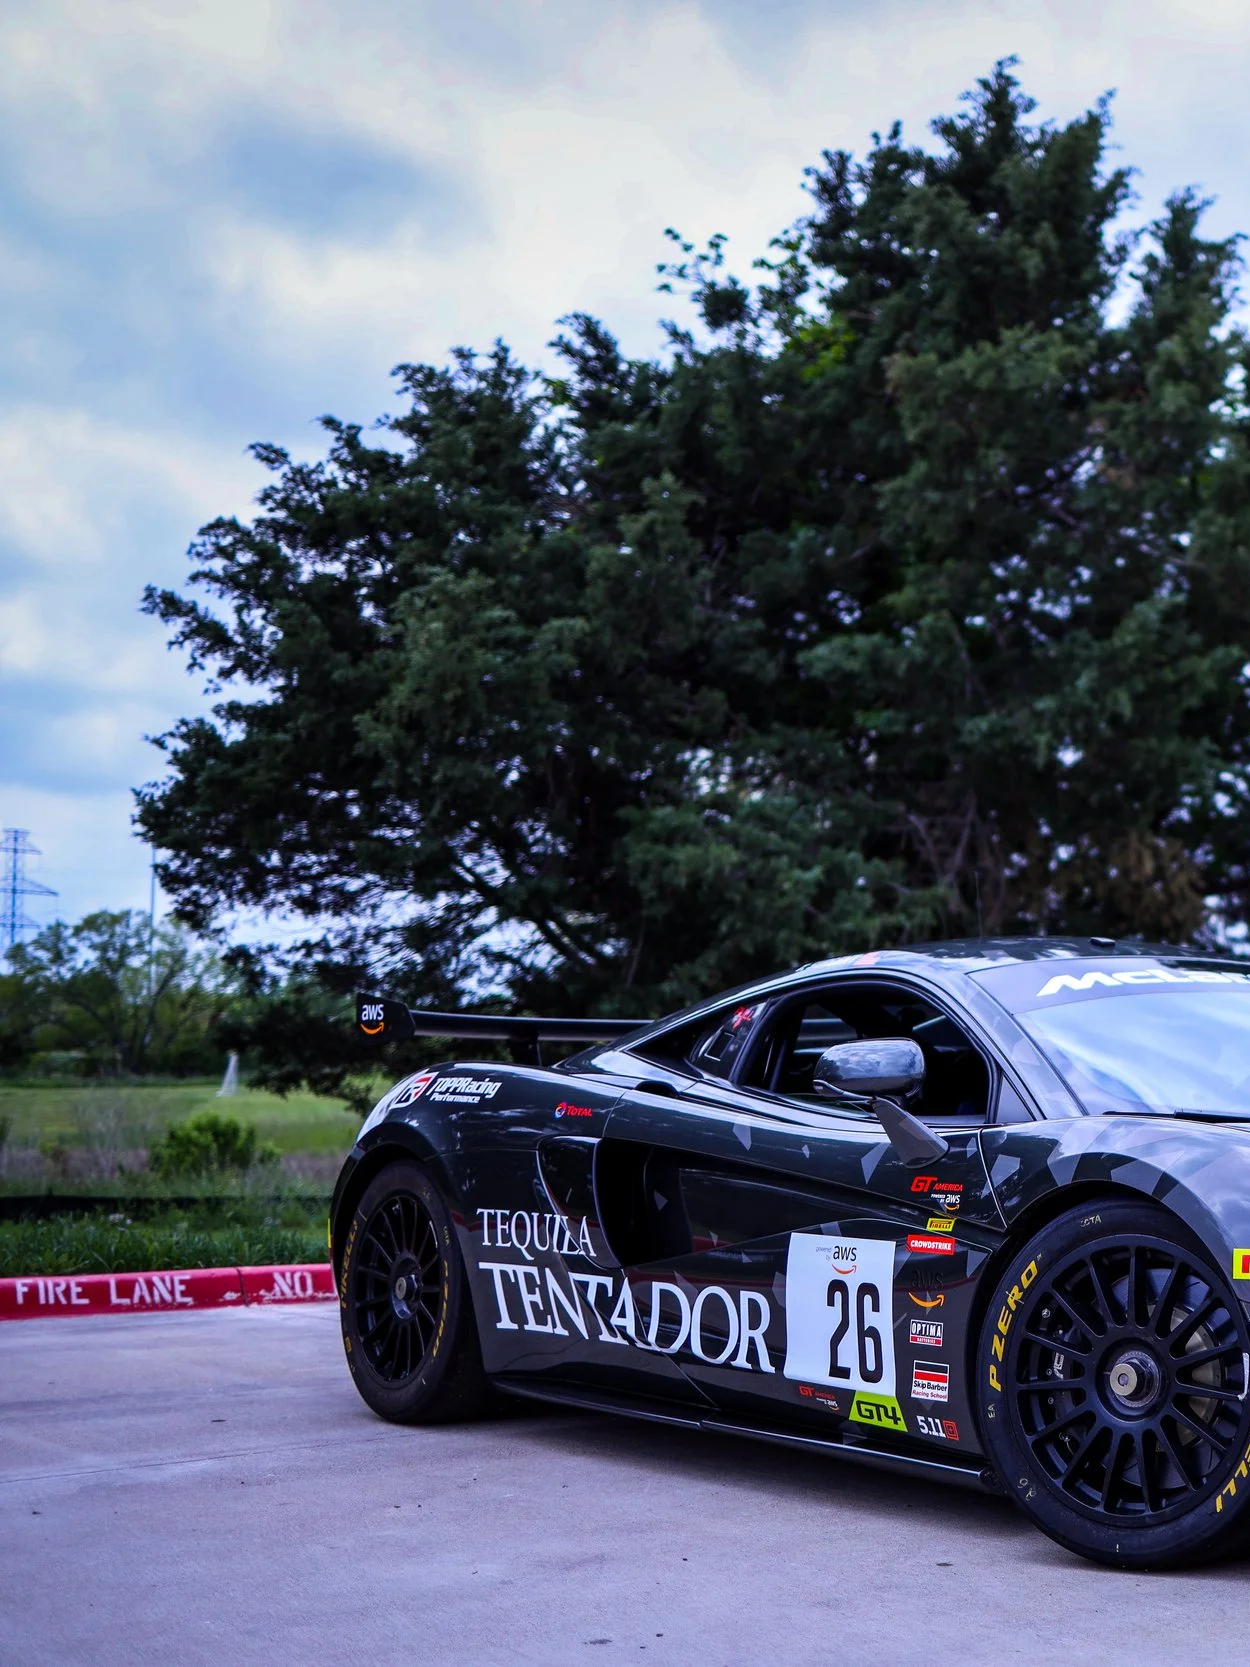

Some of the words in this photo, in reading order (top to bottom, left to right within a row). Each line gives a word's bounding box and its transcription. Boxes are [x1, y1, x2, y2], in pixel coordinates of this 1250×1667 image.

[361, 1003, 385, 1022] aws
[429, 1092, 481, 1104] Performance
[566, 1103, 593, 1117] TOTAL
[910, 1176, 938, 1193] GT
[932, 1183, 964, 1192] AMERICA
[945, 1194, 961, 1204] aws
[476, 1208, 597, 1261] TEQUILA
[832, 1245, 858, 1262] aws
[910, 1239, 952, 1251] CROWDSTRIKE
[16, 1278, 90, 1305] FIRE
[109, 1274, 195, 1305] LANE
[272, 1271, 314, 1298] NO
[478, 1261, 776, 1375] TENTADOR
[992, 1260, 1039, 1362] ZERO
[826, 1278, 884, 1385] 26
[911, 1322, 942, 1338] OPTIMA
[913, 1380, 926, 1390] Skip
[927, 1382, 948, 1392] Barber
[989, 1364, 1002, 1392] P
[912, 1390, 929, 1398] Racing
[931, 1391, 947, 1399] School
[855, 1399, 902, 1425] GT4
[917, 1415, 947, 1438] 5.11
